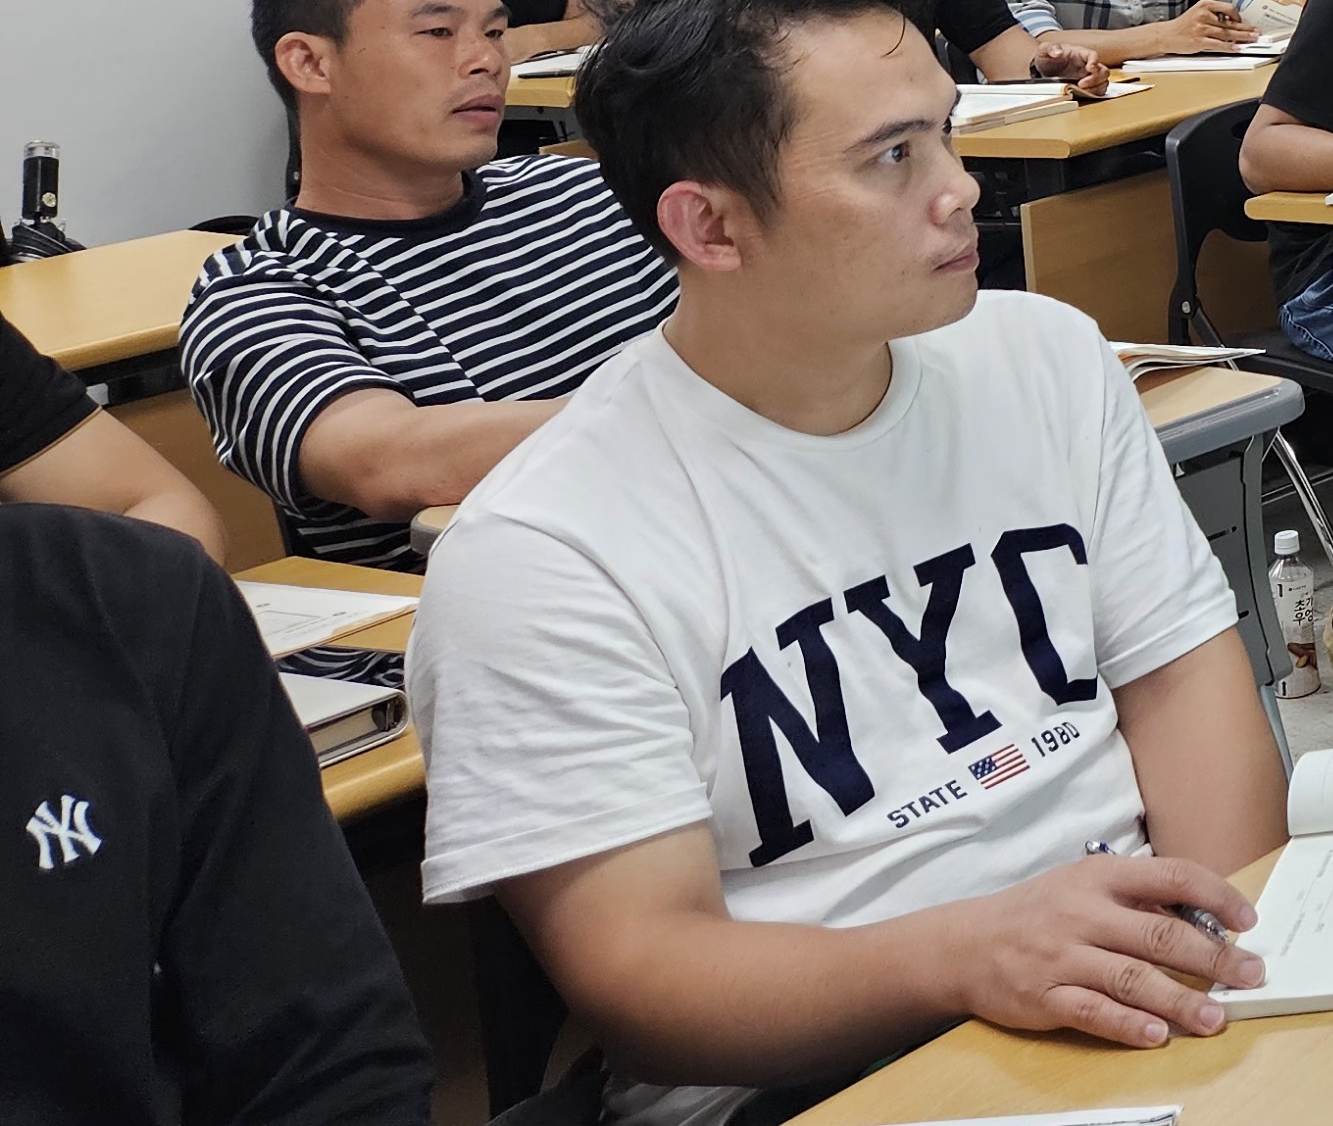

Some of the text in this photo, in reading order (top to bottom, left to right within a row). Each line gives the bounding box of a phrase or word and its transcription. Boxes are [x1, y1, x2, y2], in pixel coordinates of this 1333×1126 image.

[720, 522, 1099, 868] NYC
[887, 721, 1081, 830] STATE 1980
